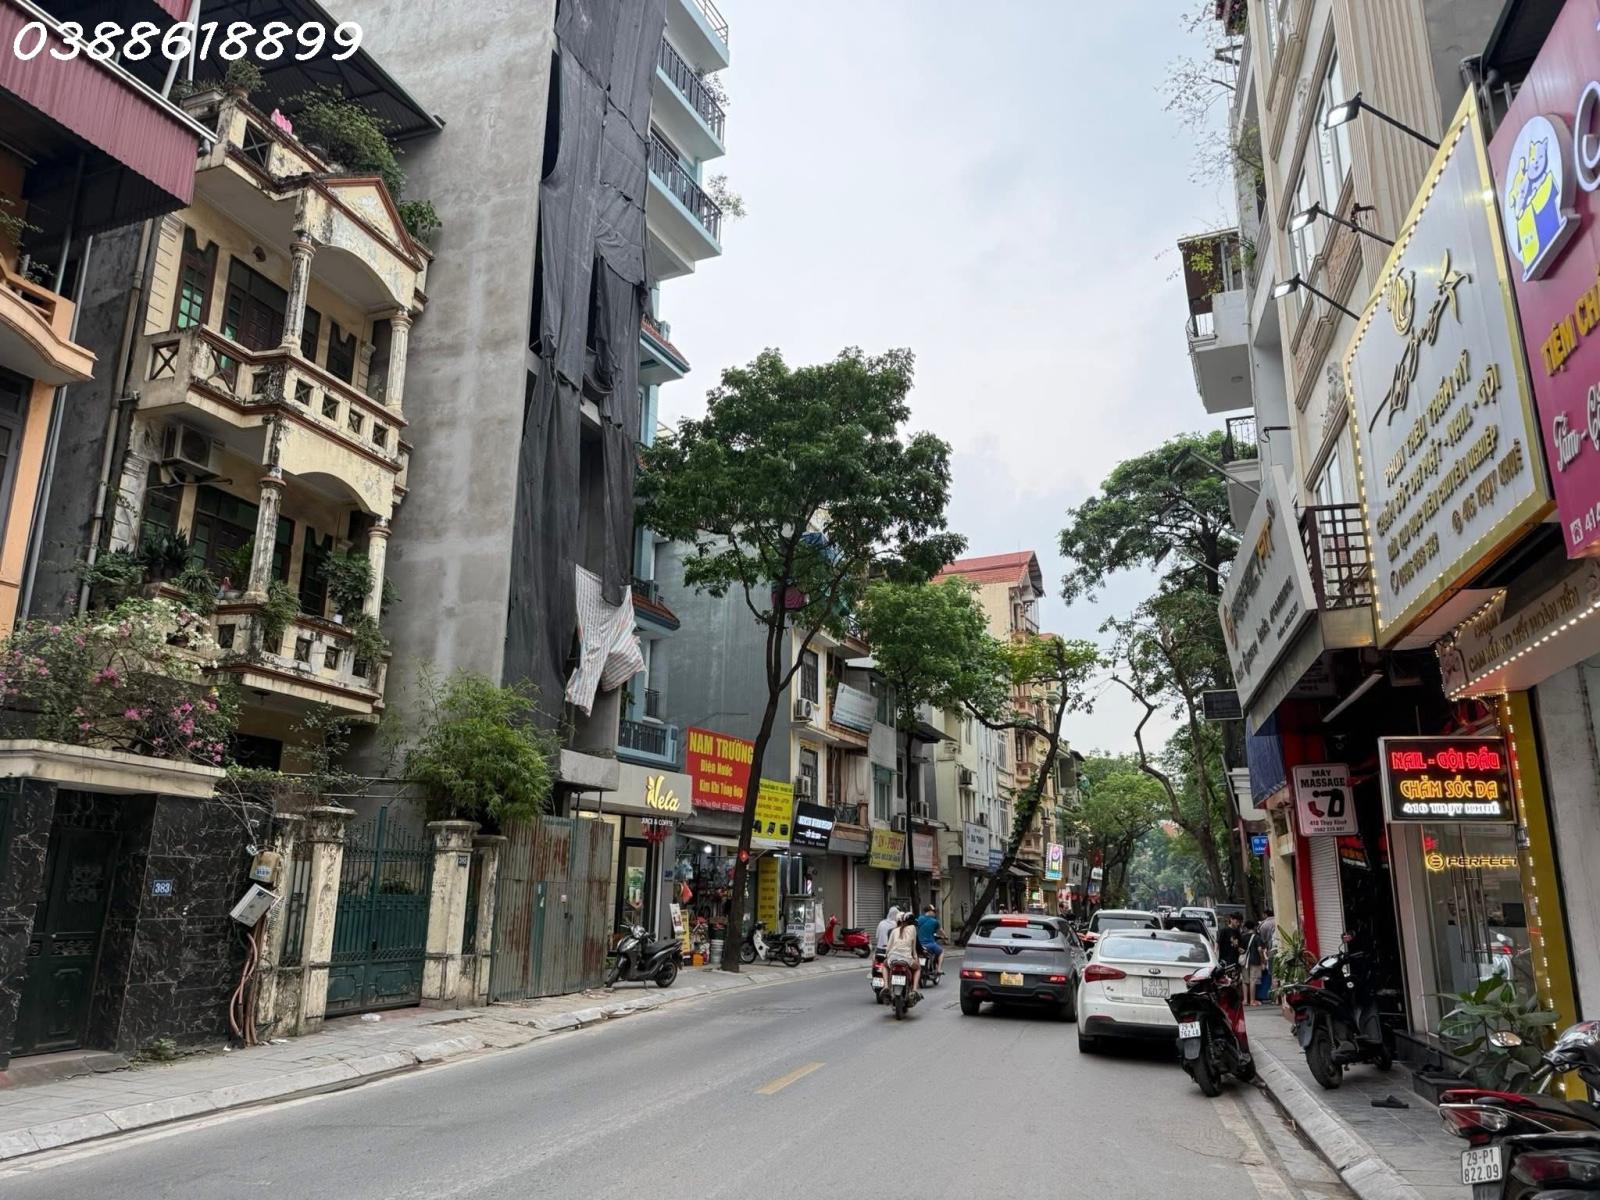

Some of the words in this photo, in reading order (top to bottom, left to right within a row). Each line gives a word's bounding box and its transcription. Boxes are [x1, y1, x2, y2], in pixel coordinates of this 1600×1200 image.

[1540, 313, 1579, 378] TIỆM
[1575, 262, 1600, 337] CH
[1453, 349, 1471, 392] MỸ
[1446, 403, 1474, 448] NAIL
[1477, 363, 1503, 404] GỘI
[689, 731, 713, 756] NAM
[716, 738, 754, 765] TRƯỜNG
[1436, 748, 1465, 772] GỘI
[1466, 746, 1500, 771] ĐẦU
[645, 775, 681, 812] Nela
[1300, 777, 1346, 789] MASSAGE
[1400, 775, 1443, 800] CHĂM
[1444, 775, 1474, 798] SÓC
[1475, 780, 1499, 800] DA
[1445, 855, 1518, 868] PERFECT
[155, 882, 171, 894] 383
[1466, 1148, 1494, 1167] 29-P1
[1464, 1164, 1499, 1183] 822.09
